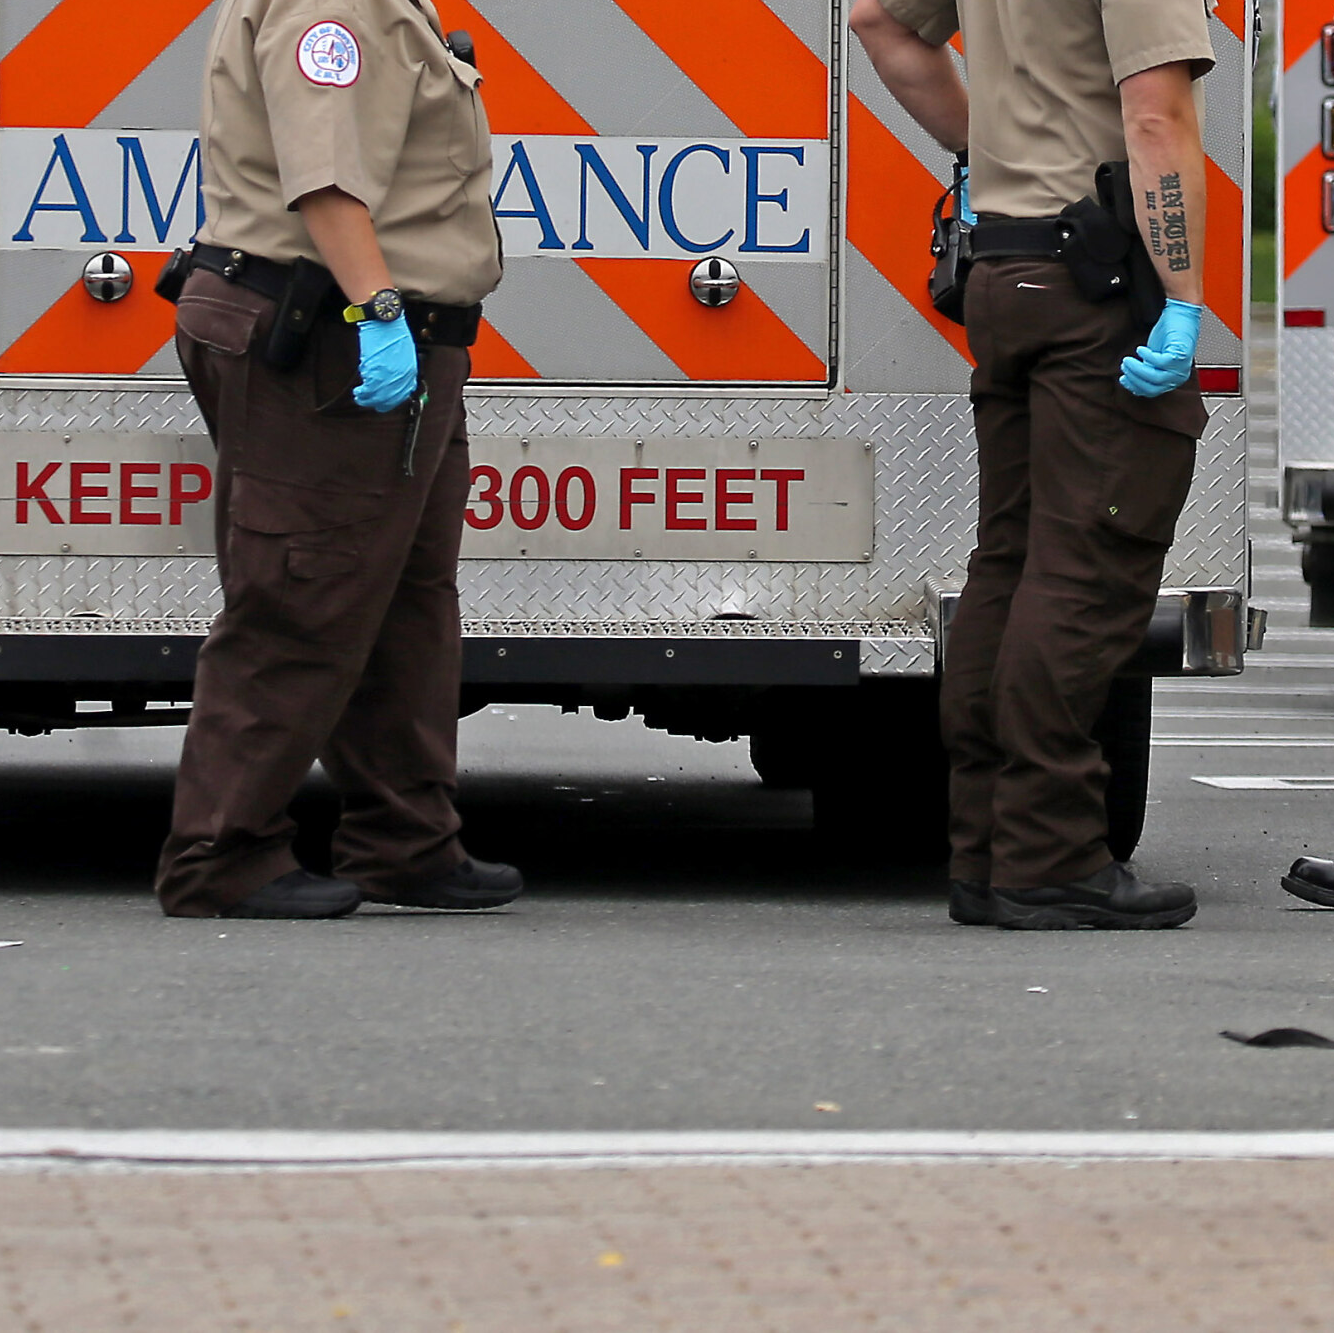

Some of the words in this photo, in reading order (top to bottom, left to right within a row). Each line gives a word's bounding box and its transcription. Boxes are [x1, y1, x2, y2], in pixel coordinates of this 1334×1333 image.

[15, 461, 213, 526] KEEP
[463, 465, 596, 531] 300
[619, 467, 805, 532] FEET
